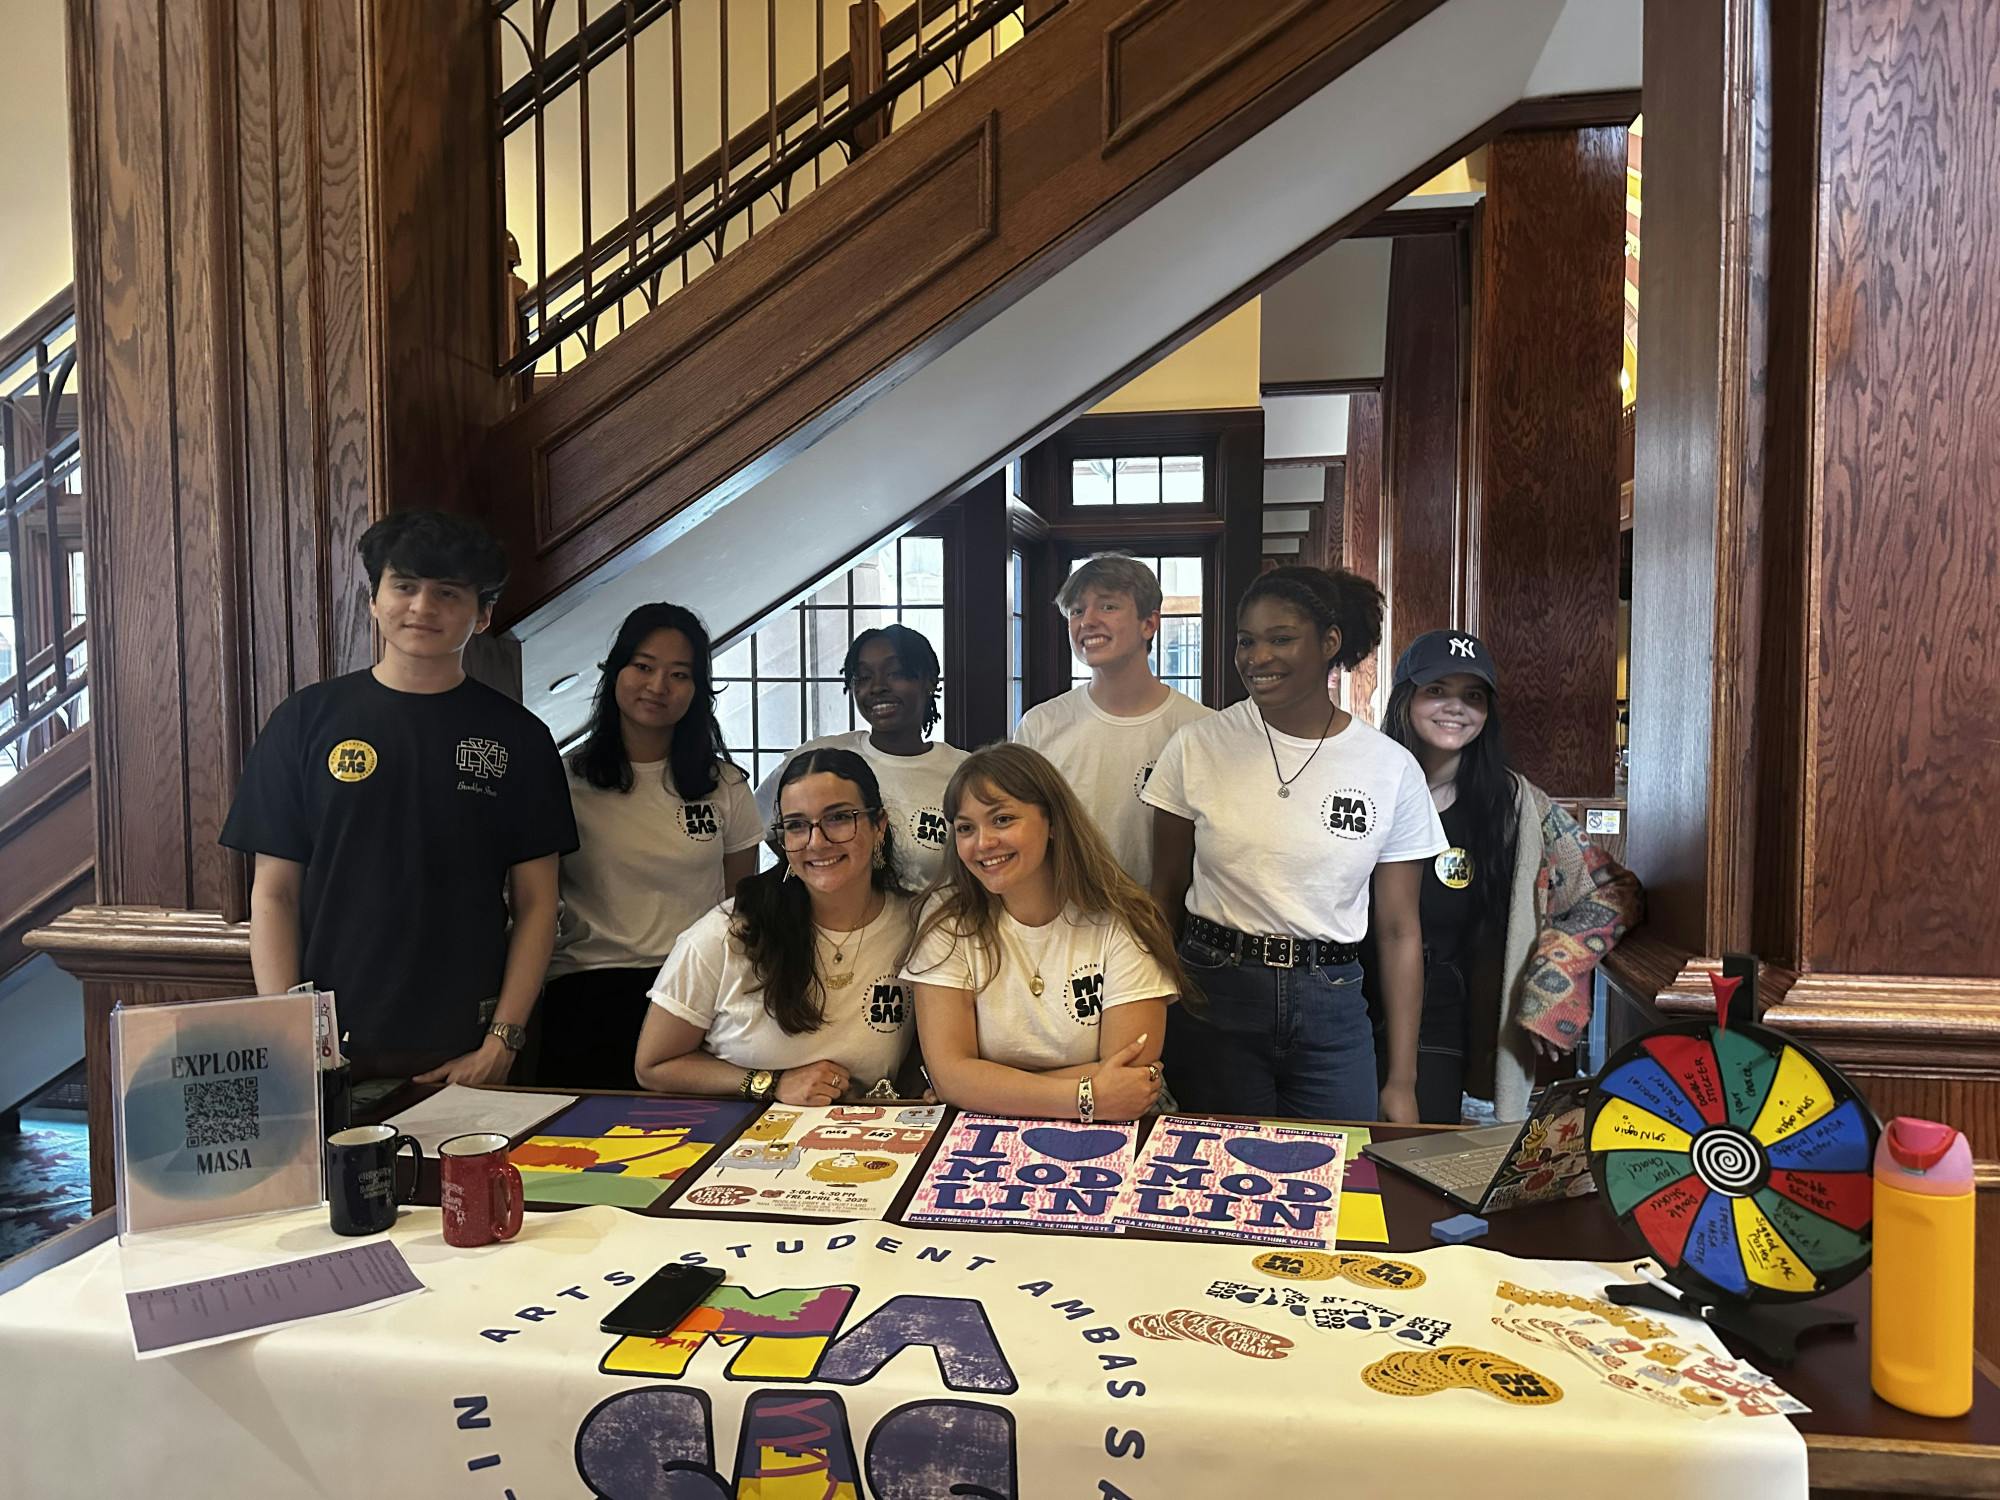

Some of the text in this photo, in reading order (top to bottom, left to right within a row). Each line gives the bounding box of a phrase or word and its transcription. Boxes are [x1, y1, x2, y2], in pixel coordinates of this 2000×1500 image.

[1448, 637, 1476, 659] NY
[684, 804, 714, 820] MA
[1332, 796, 1366, 816] MA
[686, 819, 717, 834] SAS
[920, 811, 947, 832] MA
[1330, 813, 1366, 833] SAS
[872, 985, 903, 1003] MA
[1072, 973, 1104, 998] MA
[870, 1004, 903, 1023] SAS
[1075, 994, 1102, 1018] SA
[171, 1047, 269, 1079] EXPLORE
[951, 1124, 1020, 1159] I
[1152, 1130, 1222, 1166] I
[197, 1148, 252, 1176] MASA
[935, 1159, 1123, 1189] MOD
[1137, 1162, 1332, 1203] MOD
[692, 1190, 732, 1199] ARTS
[932, 1183, 1120, 1216] LIN
[1134, 1188, 1333, 1230] LIN
[1144, 1222, 1183, 1231] MUSEUMS
[1251, 1234, 1288, 1244] RETHINK
[1290, 1237, 1320, 1247] WASTE
[1262, 1261, 1302, 1275] SAS
[1268, 1254, 1304, 1268] MA
[1377, 1262, 1414, 1280] MA
[1366, 1268, 1406, 1285] SAS
[480, 1271, 636, 1343] ARTS
[679, 1234, 996, 1271] STUDENT
[1205, 1281, 1230, 1299] LIN
[1312, 1308, 1332, 1329] LIN
[1328, 1308, 1346, 1330] MOD
[599, 1284, 1019, 1395] MA
[1228, 1332, 1269, 1348] ARTS
[1238, 1327, 1272, 1340] MODLIN
[1231, 1340, 1274, 1359] CRAWL
[1490, 1373, 1541, 1386] SAS
[1500, 1385, 1551, 1397] MA
